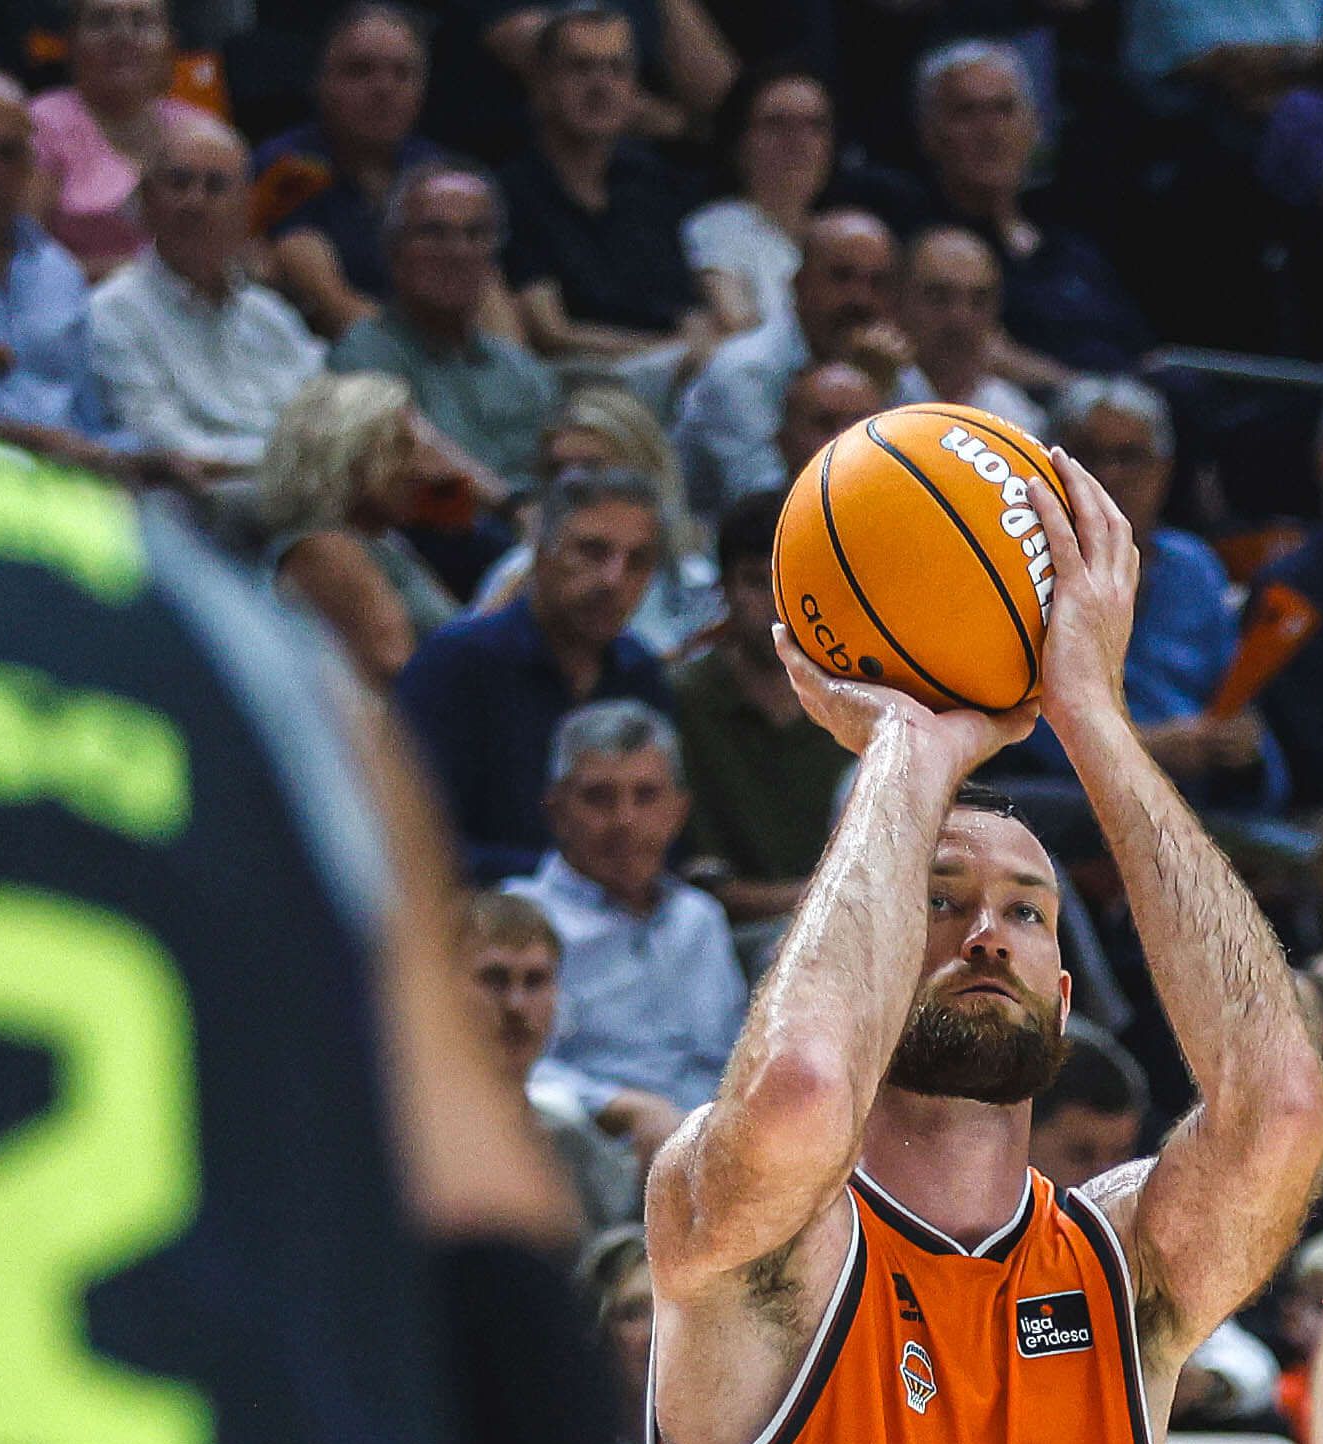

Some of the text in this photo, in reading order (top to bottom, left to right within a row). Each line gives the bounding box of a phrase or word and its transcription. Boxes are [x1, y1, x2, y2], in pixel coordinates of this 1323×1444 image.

[801, 594, 852, 672] acb
[1020, 1316, 1053, 1334] liga
[1025, 1328, 1089, 1348] endesa
